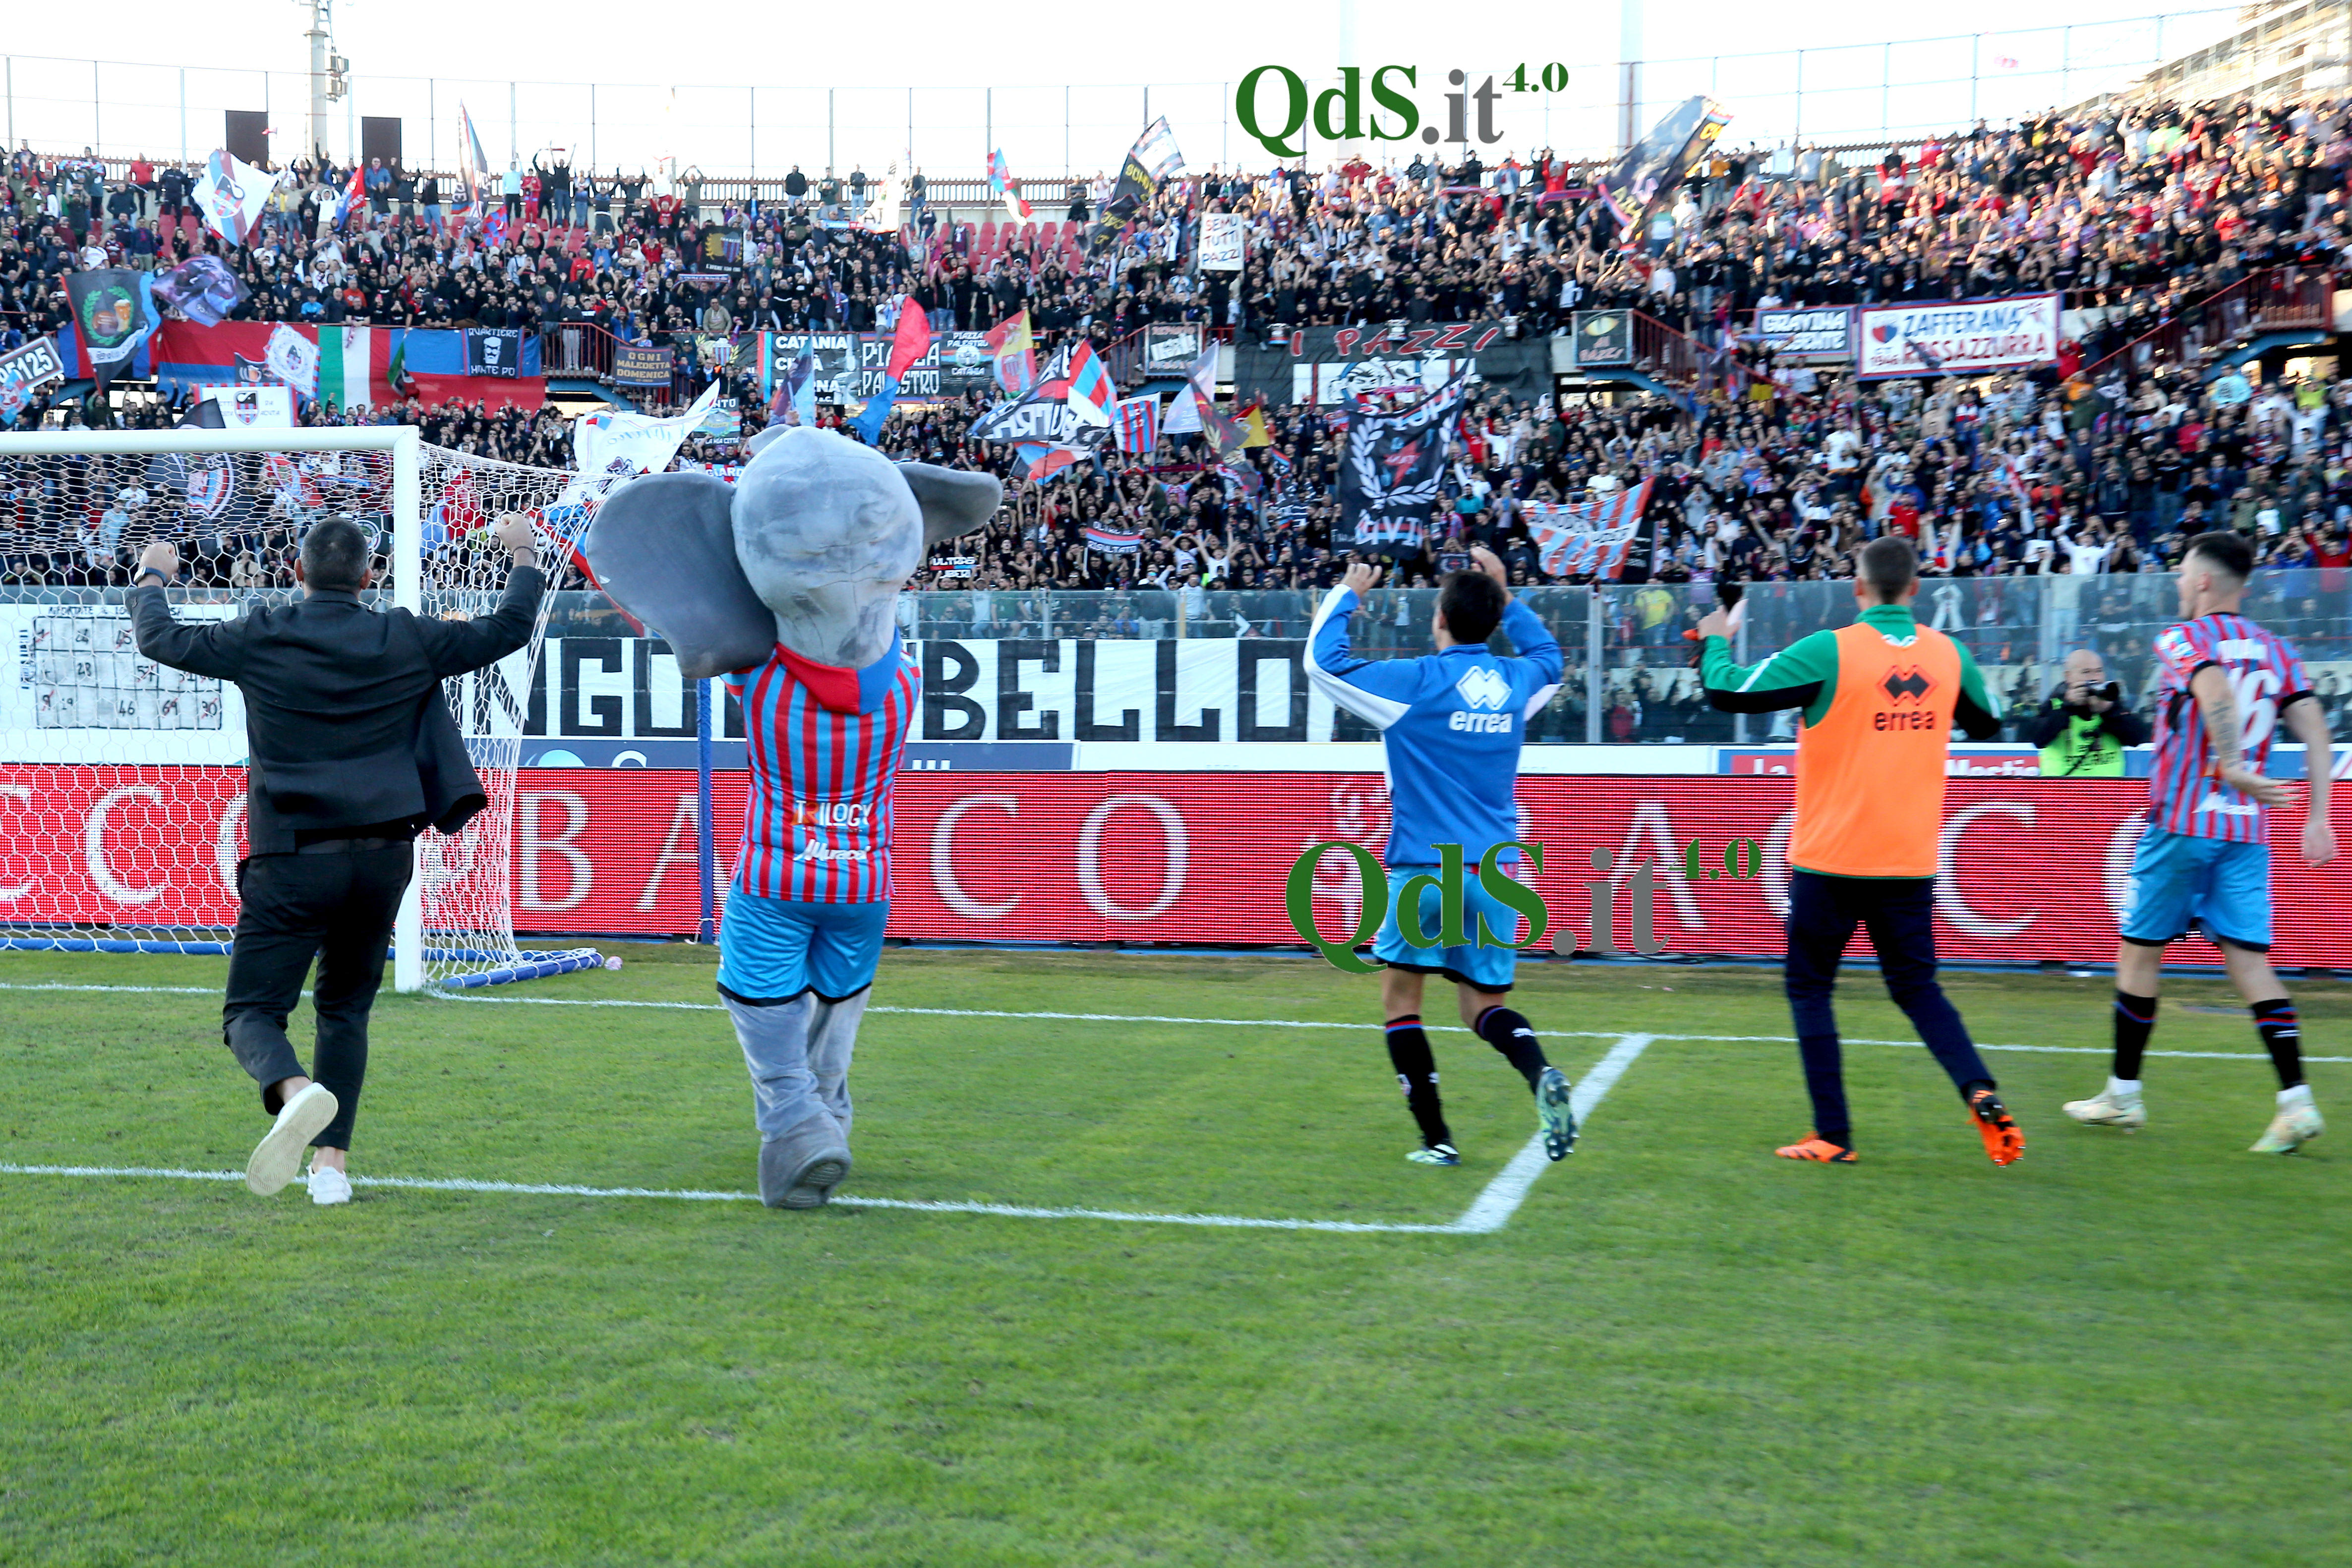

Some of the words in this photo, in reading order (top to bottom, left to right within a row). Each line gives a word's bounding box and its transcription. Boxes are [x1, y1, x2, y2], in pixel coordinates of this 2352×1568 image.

[468, 328, 518, 337] QUARTIERE
[1291, 330, 1304, 356] I
[1333, 323, 1501, 356] PAZZI
[628, 352, 661, 361] OGNI
[617, 359, 670, 369] MALEDETTA
[502, 367, 515, 376] PO
[617, 368, 670, 378] DOMENICA
[863, 370, 940, 394] PASTRO
[933, 556, 976, 566] ULTRAS
[923, 639, 1309, 741] BELLO
[119, 700, 135, 716] 46
[2227, 667, 2281, 750] 6
[795, 800, 874, 826] TRILOGY
